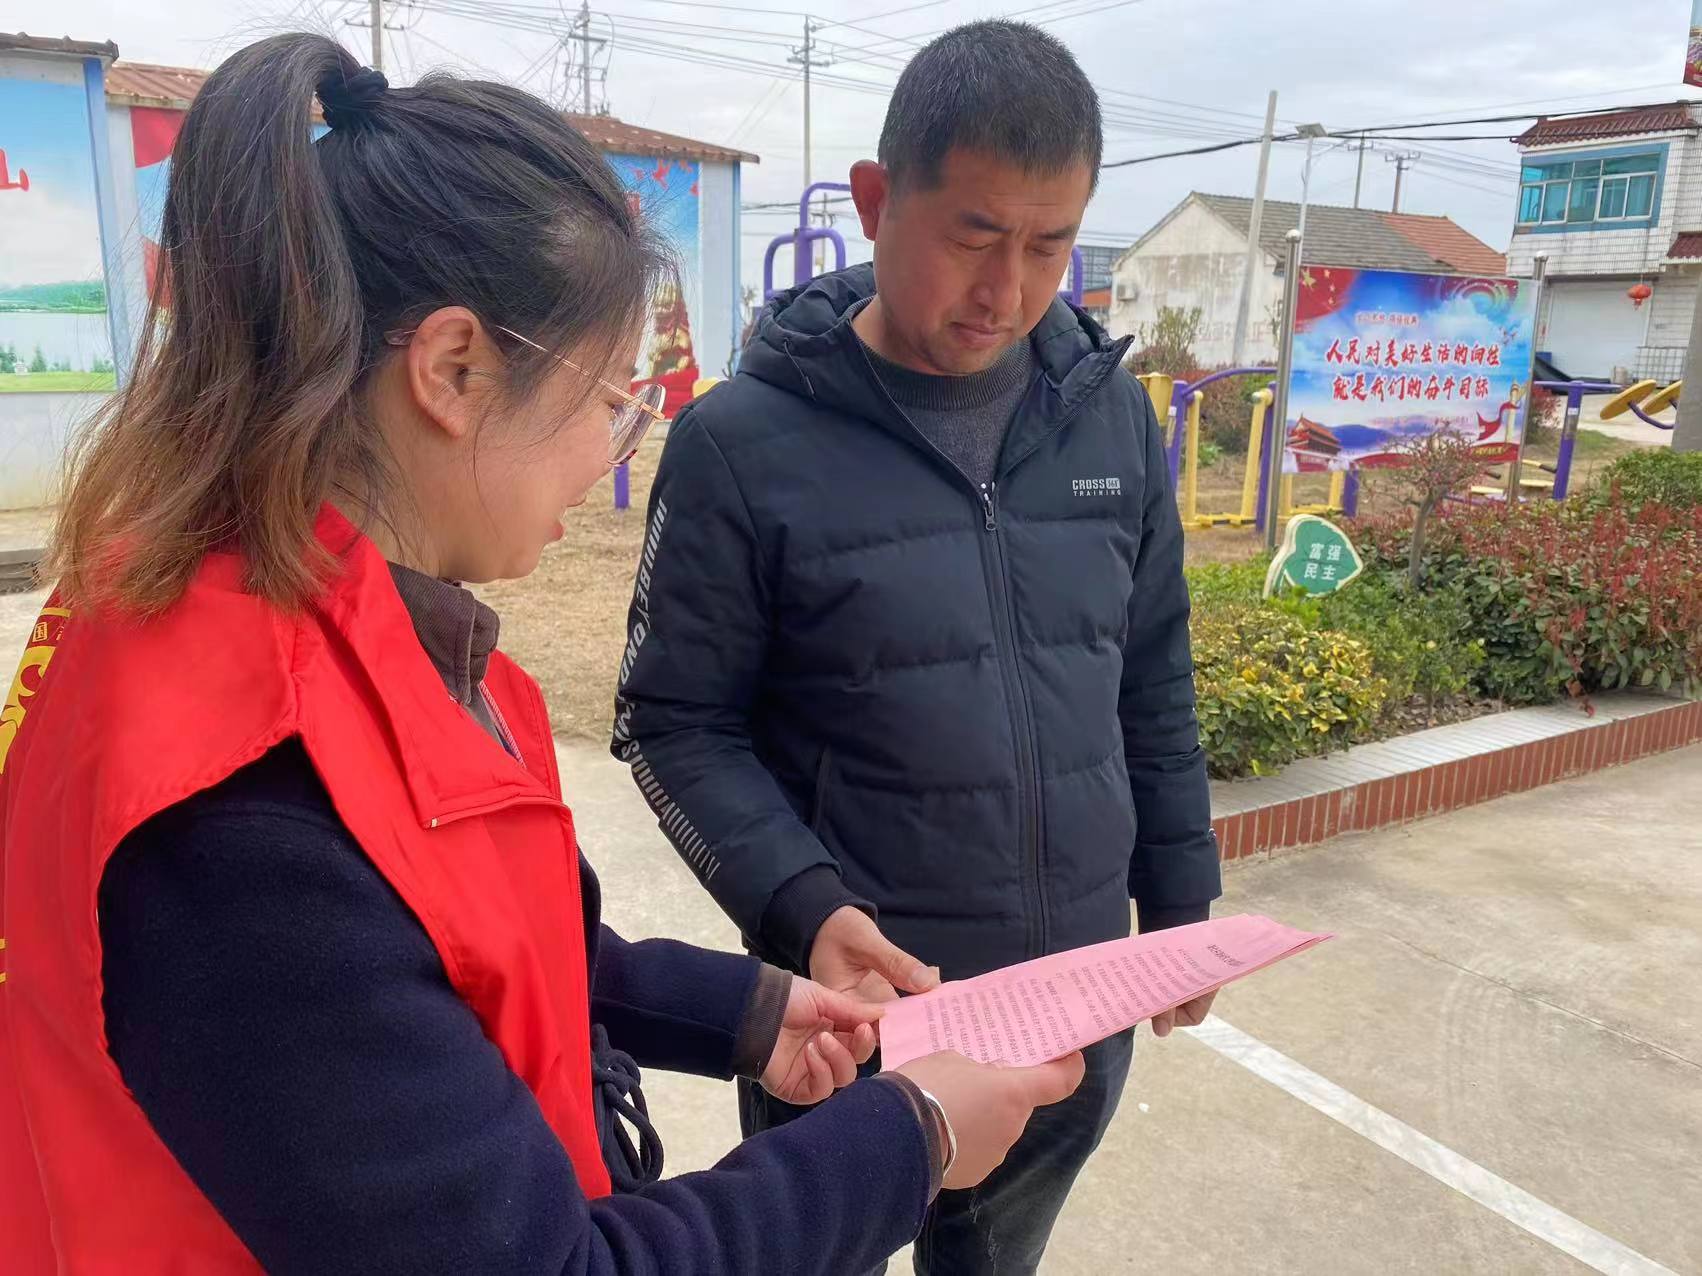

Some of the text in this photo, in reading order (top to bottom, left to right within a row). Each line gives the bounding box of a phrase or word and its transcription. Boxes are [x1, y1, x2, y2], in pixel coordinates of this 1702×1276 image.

[1326, 338, 1501, 367] 人民对美好生活的向往
[1332, 374, 1489, 402] 就是我们的奋斗目标
[1072, 479, 1105, 490] CROSS
[1309, 543, 1342, 560] 富强
[1304, 562, 1336, 580] 民主
[620, 564, 651, 685] BEYOND
